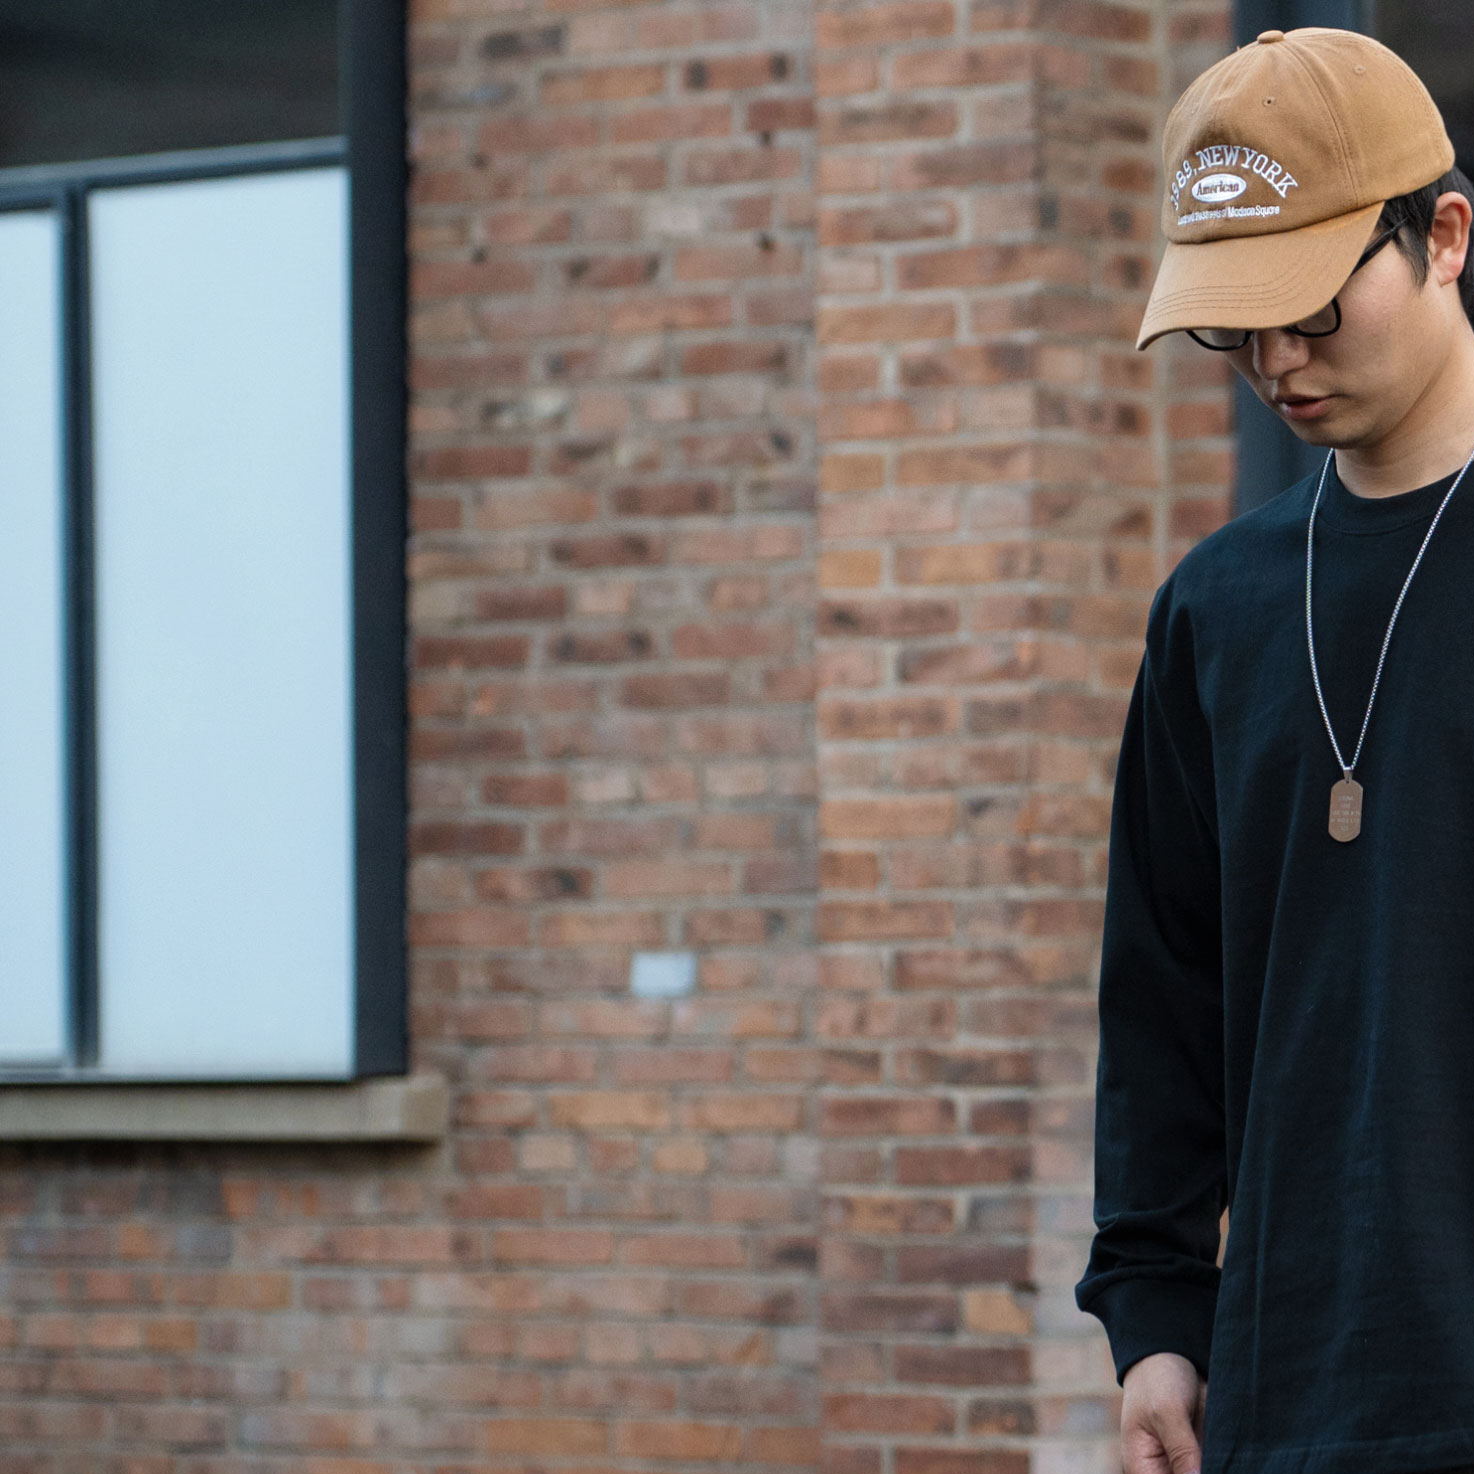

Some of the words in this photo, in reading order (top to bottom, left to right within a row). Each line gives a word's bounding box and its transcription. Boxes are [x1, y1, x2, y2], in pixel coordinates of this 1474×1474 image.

[1195, 145, 1241, 171] NEW
[1241, 147, 1298, 198] YORK
[1196, 180, 1239, 196] American
